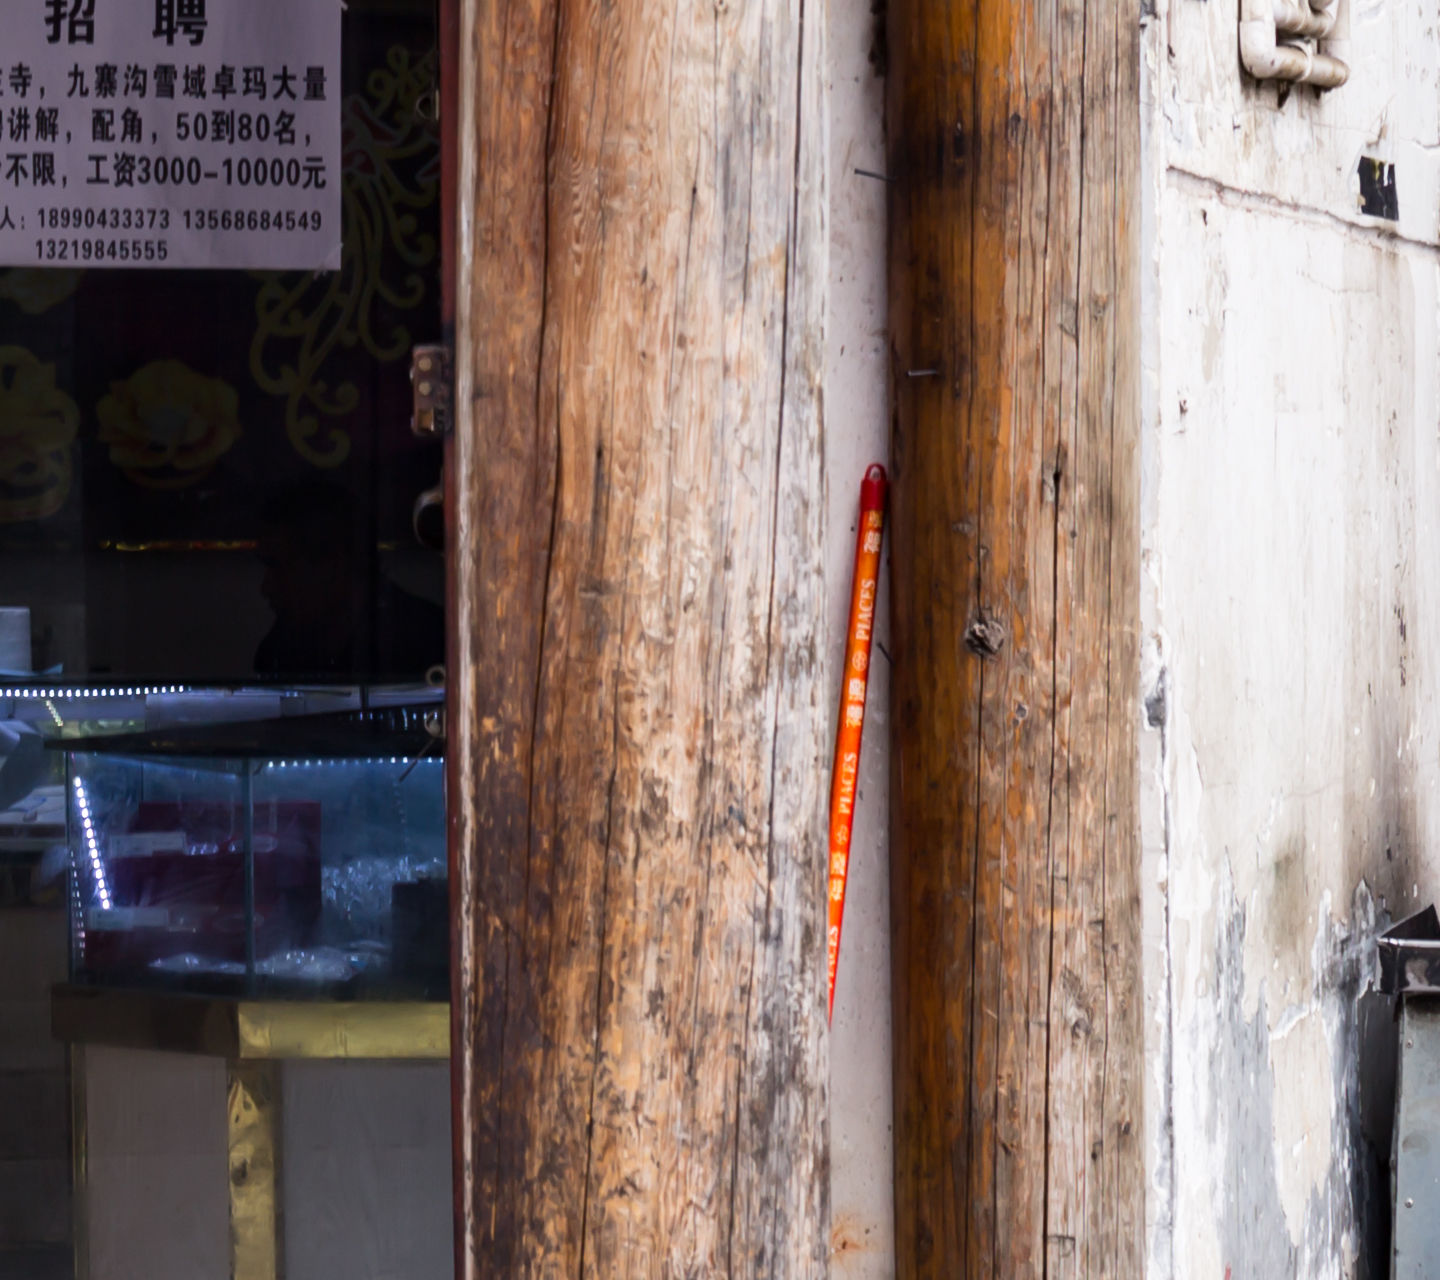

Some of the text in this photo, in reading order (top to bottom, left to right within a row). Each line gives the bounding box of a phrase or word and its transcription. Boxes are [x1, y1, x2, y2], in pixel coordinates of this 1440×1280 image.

[0, 107, 313, 147] 讲解，配角，50到80名，
[0, 152, 326, 189] 不限，工资3000-10000元
[38, 207, 170, 230] 18990433373
[183, 209, 322, 231] 13568684549
[36, 239, 168, 260] 13219845555
